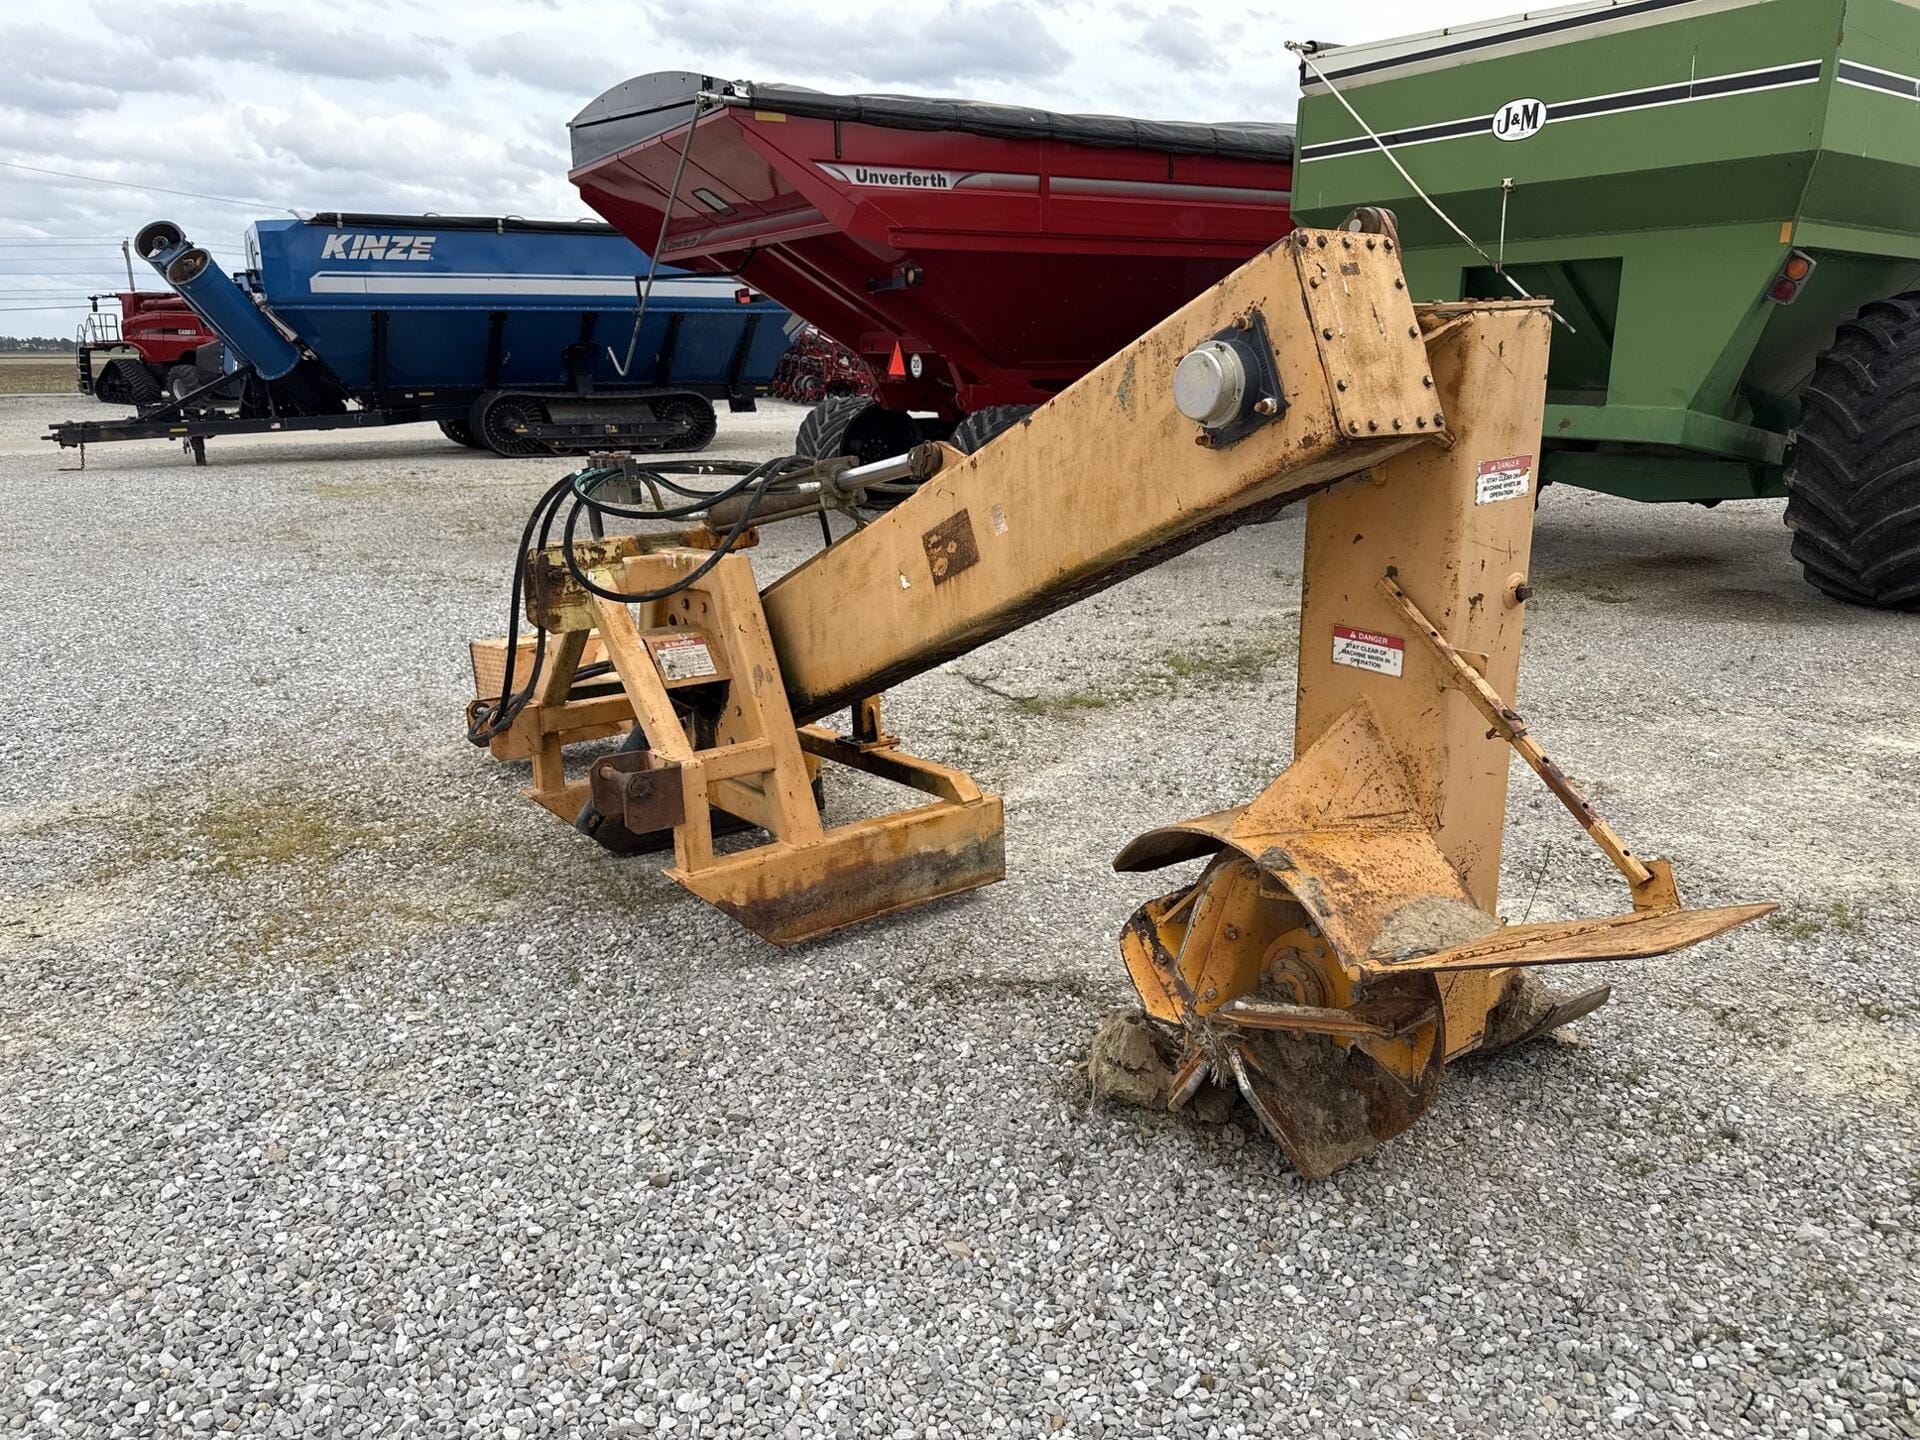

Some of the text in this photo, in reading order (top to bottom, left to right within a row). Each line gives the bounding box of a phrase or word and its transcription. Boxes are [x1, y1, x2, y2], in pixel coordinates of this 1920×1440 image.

[1497, 102, 1540, 134] J&M
[855, 168, 947, 188] Unverferth
[321, 234, 437, 260] KINZE
[1358, 633, 1388, 645] DANGER
[1341, 649, 1366, 658] MACHINE
[1367, 654, 1384, 662] WHEN
[1360, 646, 1378, 654] CLEAR
[1350, 657, 1381, 668] OPERATION
